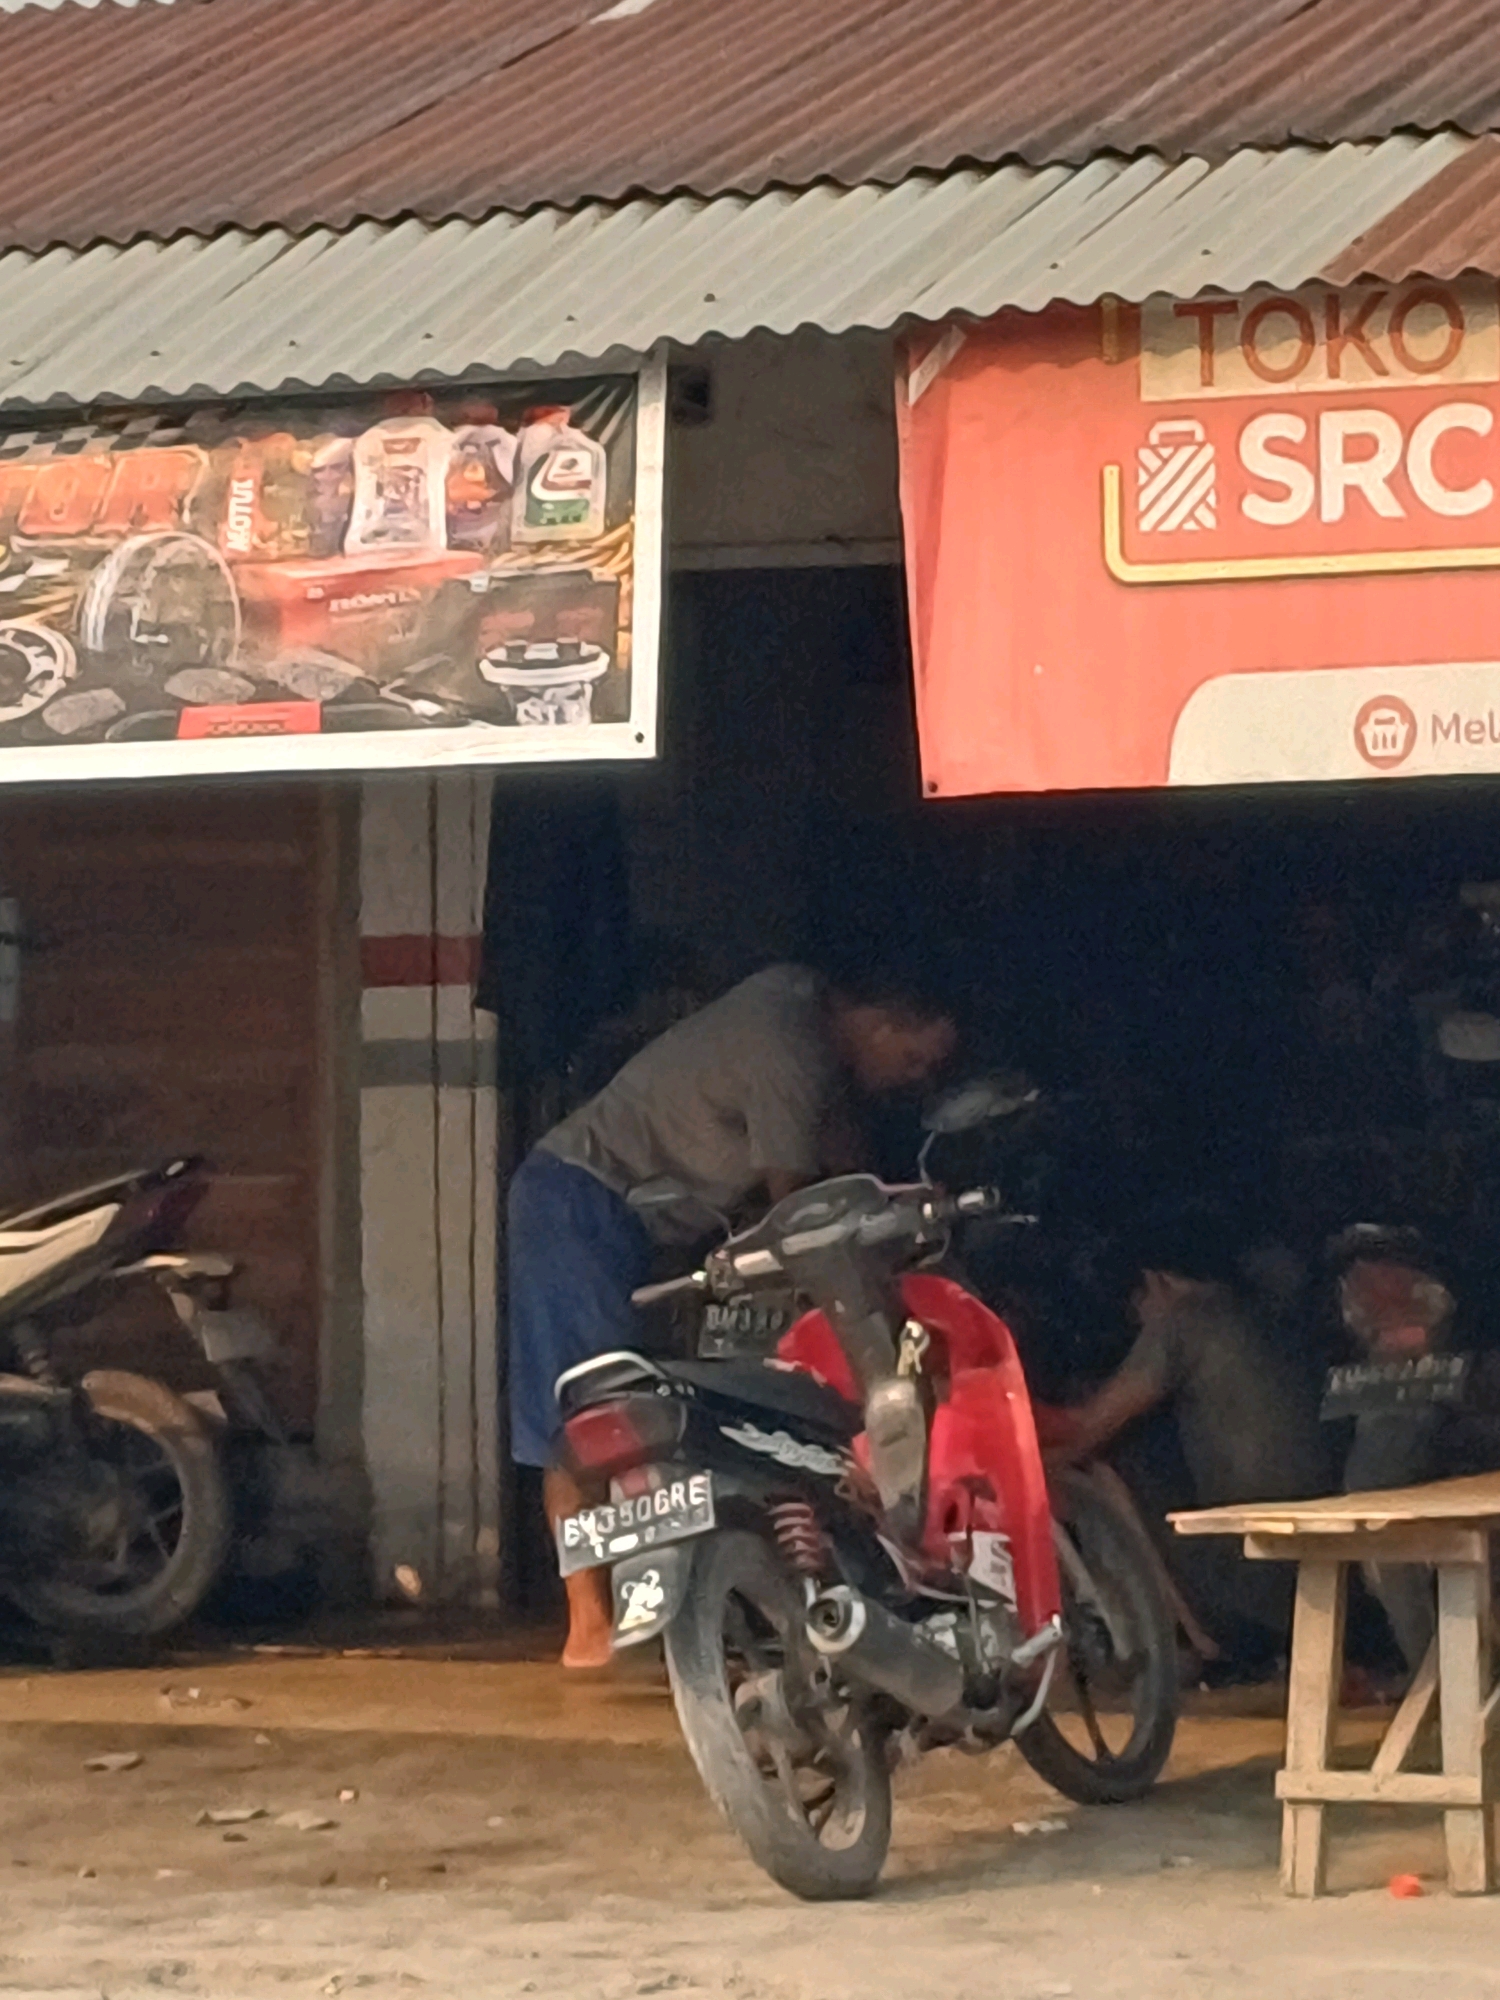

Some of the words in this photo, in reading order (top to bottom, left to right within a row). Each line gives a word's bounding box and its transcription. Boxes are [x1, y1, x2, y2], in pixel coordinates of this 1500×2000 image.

[1173, 287, 1465, 387] TOKO
[1238, 402, 1495, 526] SRC
[225, 478, 254, 552] MOTUL
